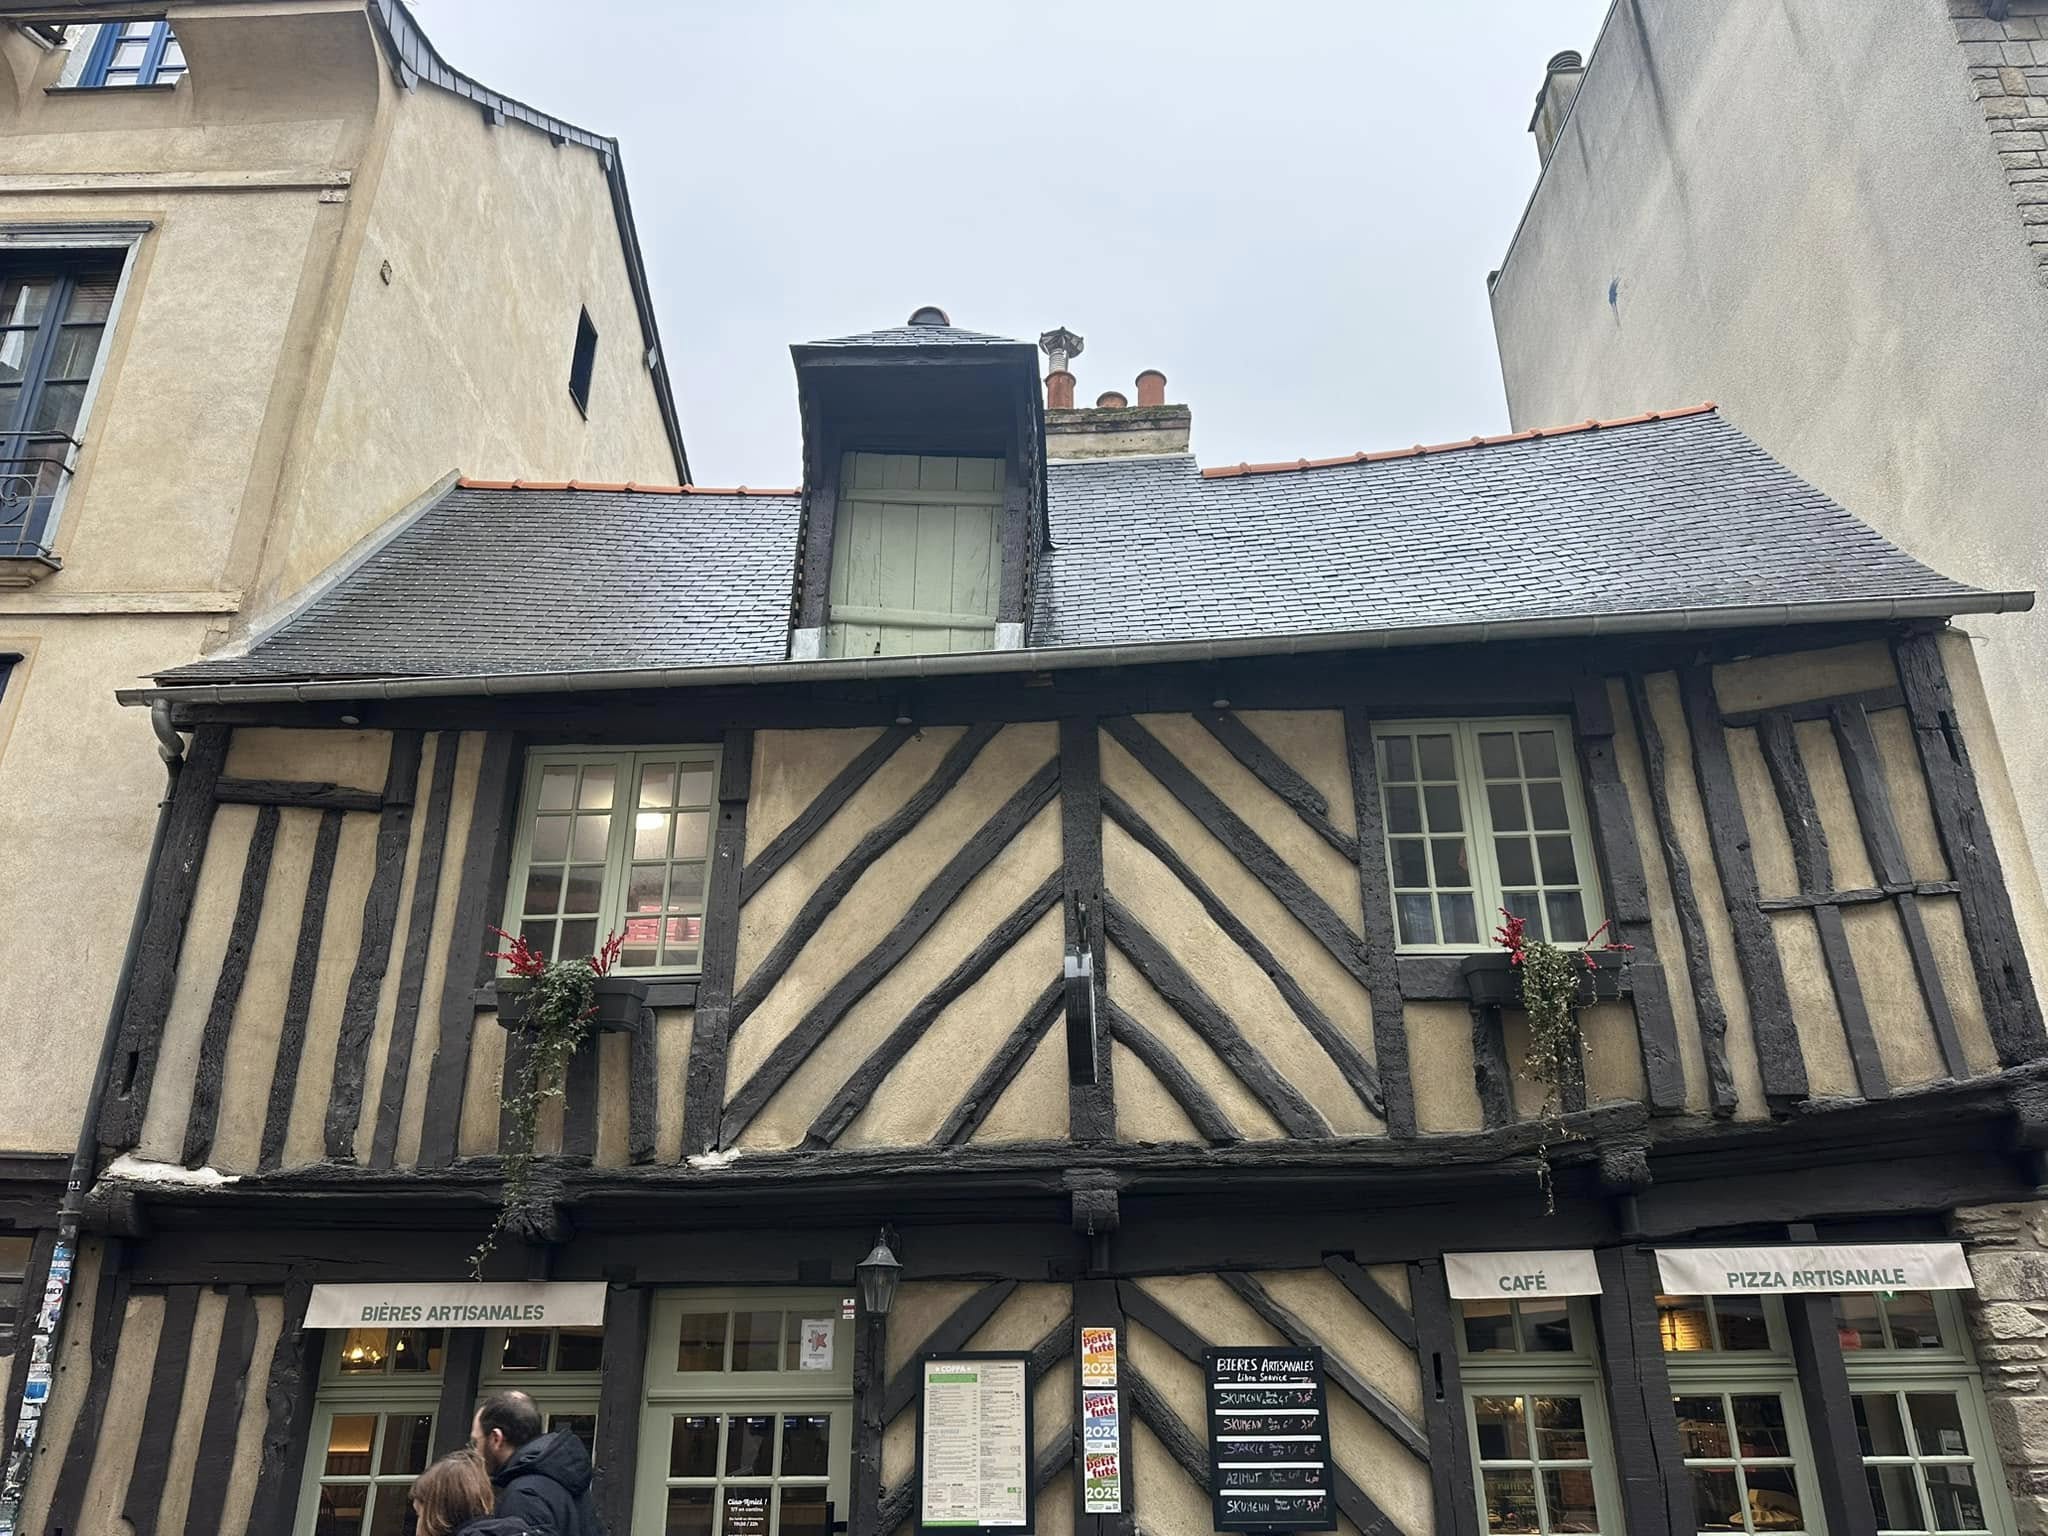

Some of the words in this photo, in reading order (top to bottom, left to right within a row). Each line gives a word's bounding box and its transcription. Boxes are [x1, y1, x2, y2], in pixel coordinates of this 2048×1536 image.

[1499, 1270, 1547, 1291] CAFÉ
[1727, 1271, 1787, 1289] PIZZA
[1792, 1268, 1906, 1287] ARTISANALE
[361, 1302, 422, 1321] BIÈRES
[426, 1305, 545, 1321] ARTISANALES
[1217, 1358, 1258, 1372] BIERES
[1086, 1426, 1117, 1438] 2024
[1087, 1487, 1119, 1499] 2025
